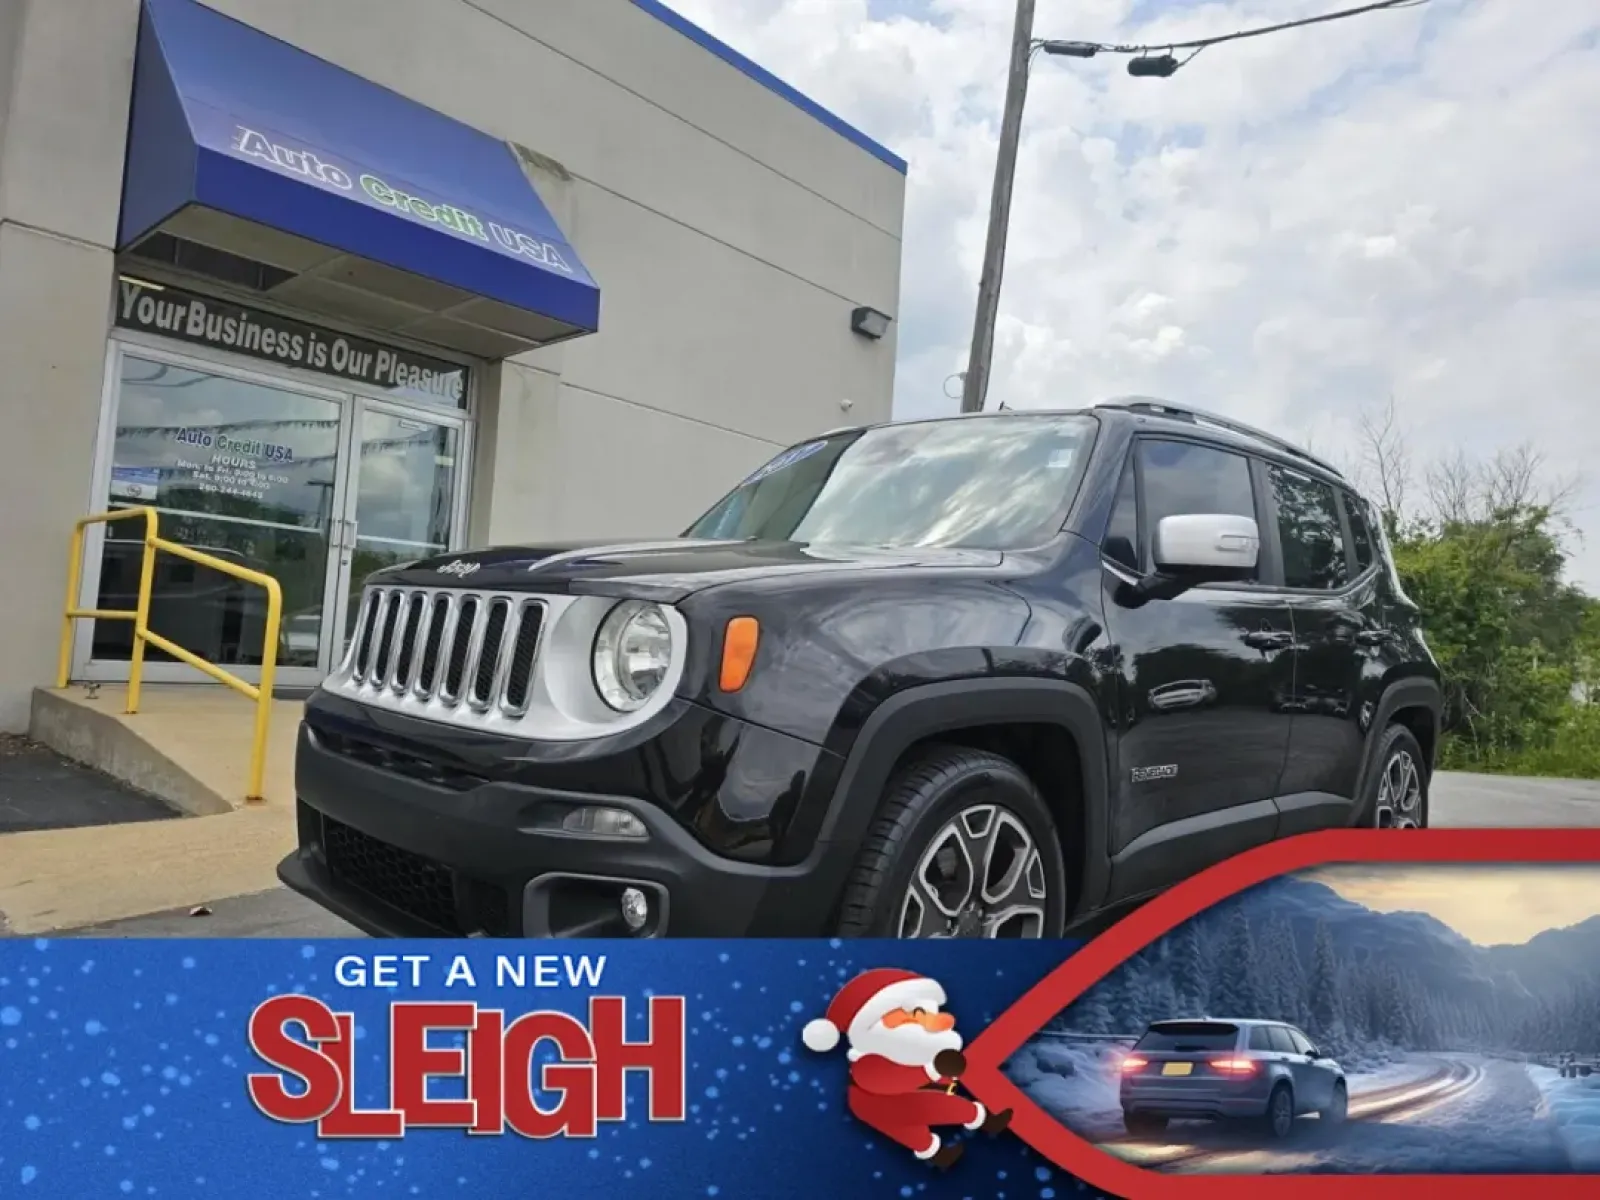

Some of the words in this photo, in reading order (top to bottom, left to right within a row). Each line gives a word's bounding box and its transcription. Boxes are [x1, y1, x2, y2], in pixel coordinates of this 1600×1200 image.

[233, 124, 352, 190] Auto
[360, 174, 489, 242] Credit
[488, 222, 573, 273] USA
[307, 332, 328, 368] is
[331, 338, 373, 377] Our
[374, 350, 464, 400] Pleasure
[177, 427, 212, 447] Auto
[217, 434, 261, 455] Credit
[264, 443, 294, 462] USA
[211, 454, 256, 469] HOURS
